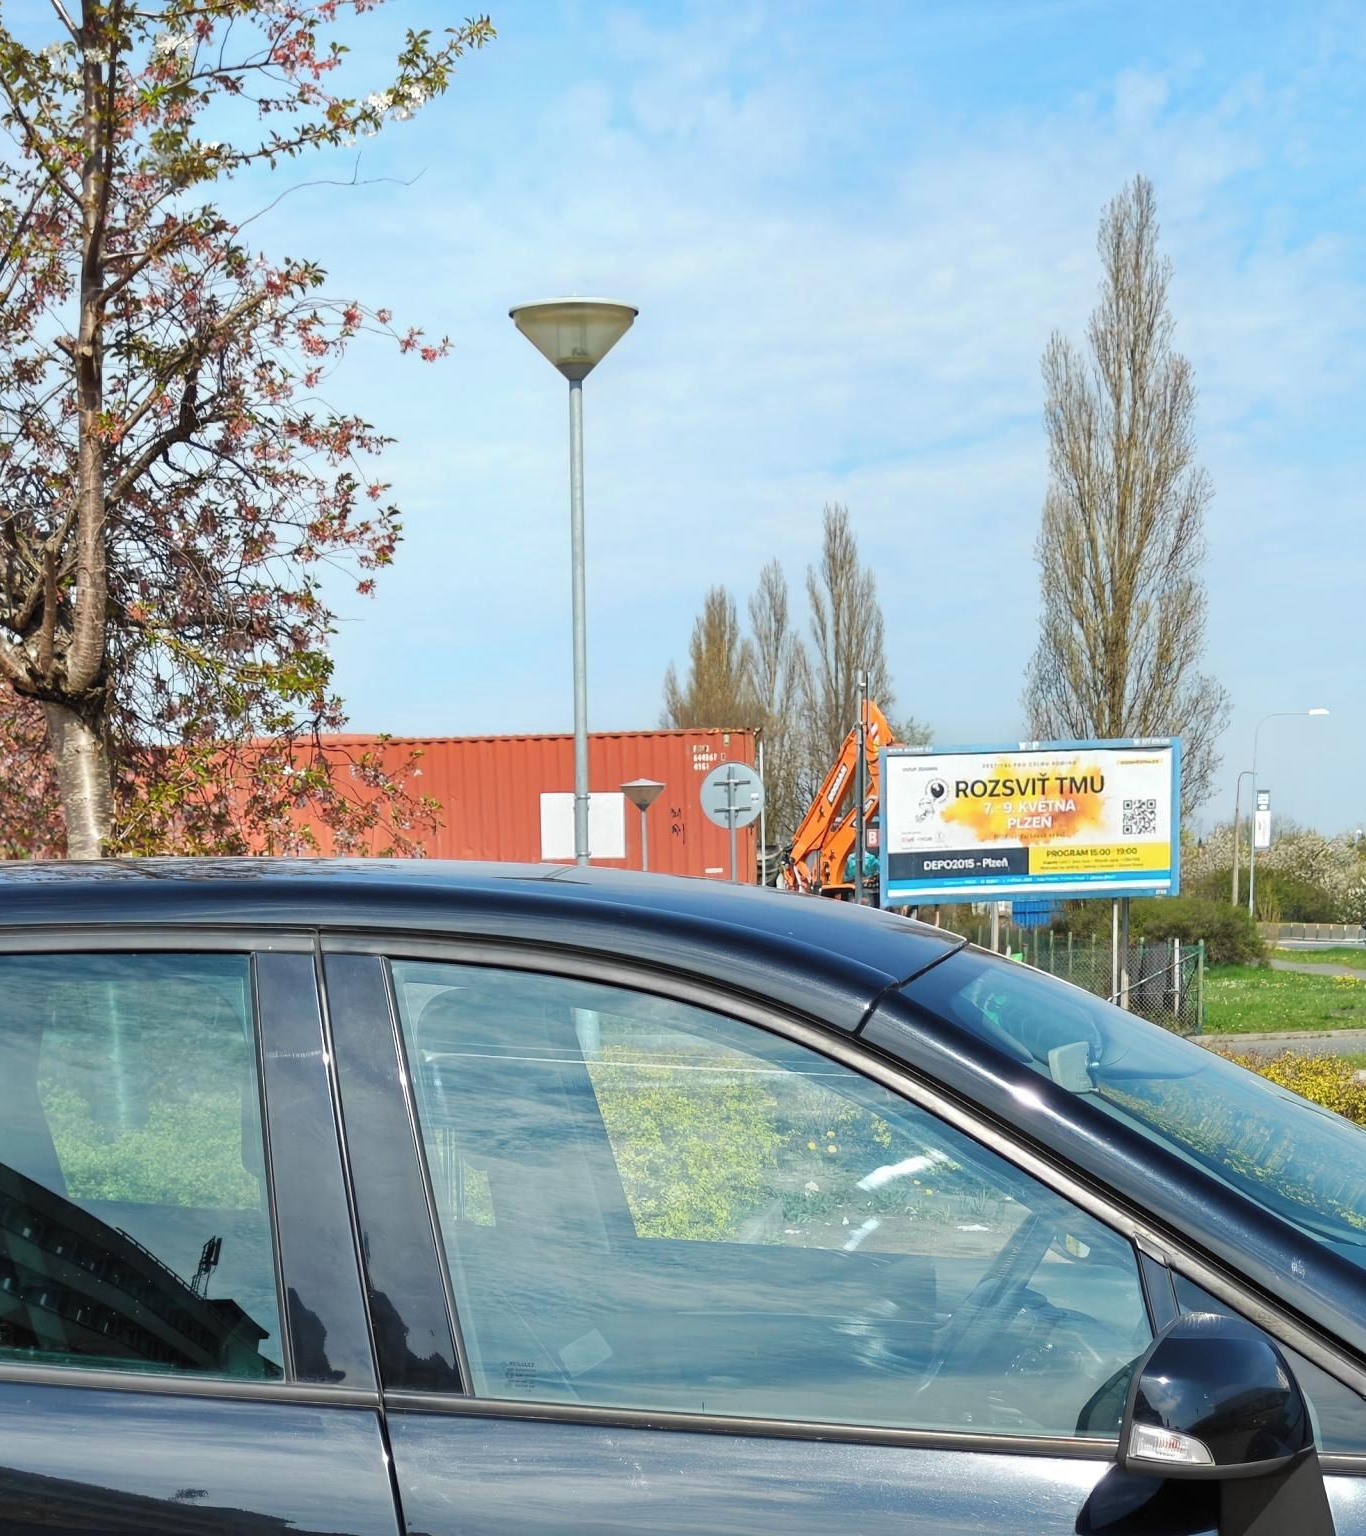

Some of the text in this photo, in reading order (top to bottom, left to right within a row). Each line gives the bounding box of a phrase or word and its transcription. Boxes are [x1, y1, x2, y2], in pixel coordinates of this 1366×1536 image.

[955, 773, 1105, 798] ROZSVIŤ TMU
[1019, 799, 1076, 814] KVĚTNA
[1007, 813, 1053, 829] PLZEŇ
[1046, 848, 1088, 857] PROGRAM
[923, 859, 975, 871] DEPO2015
